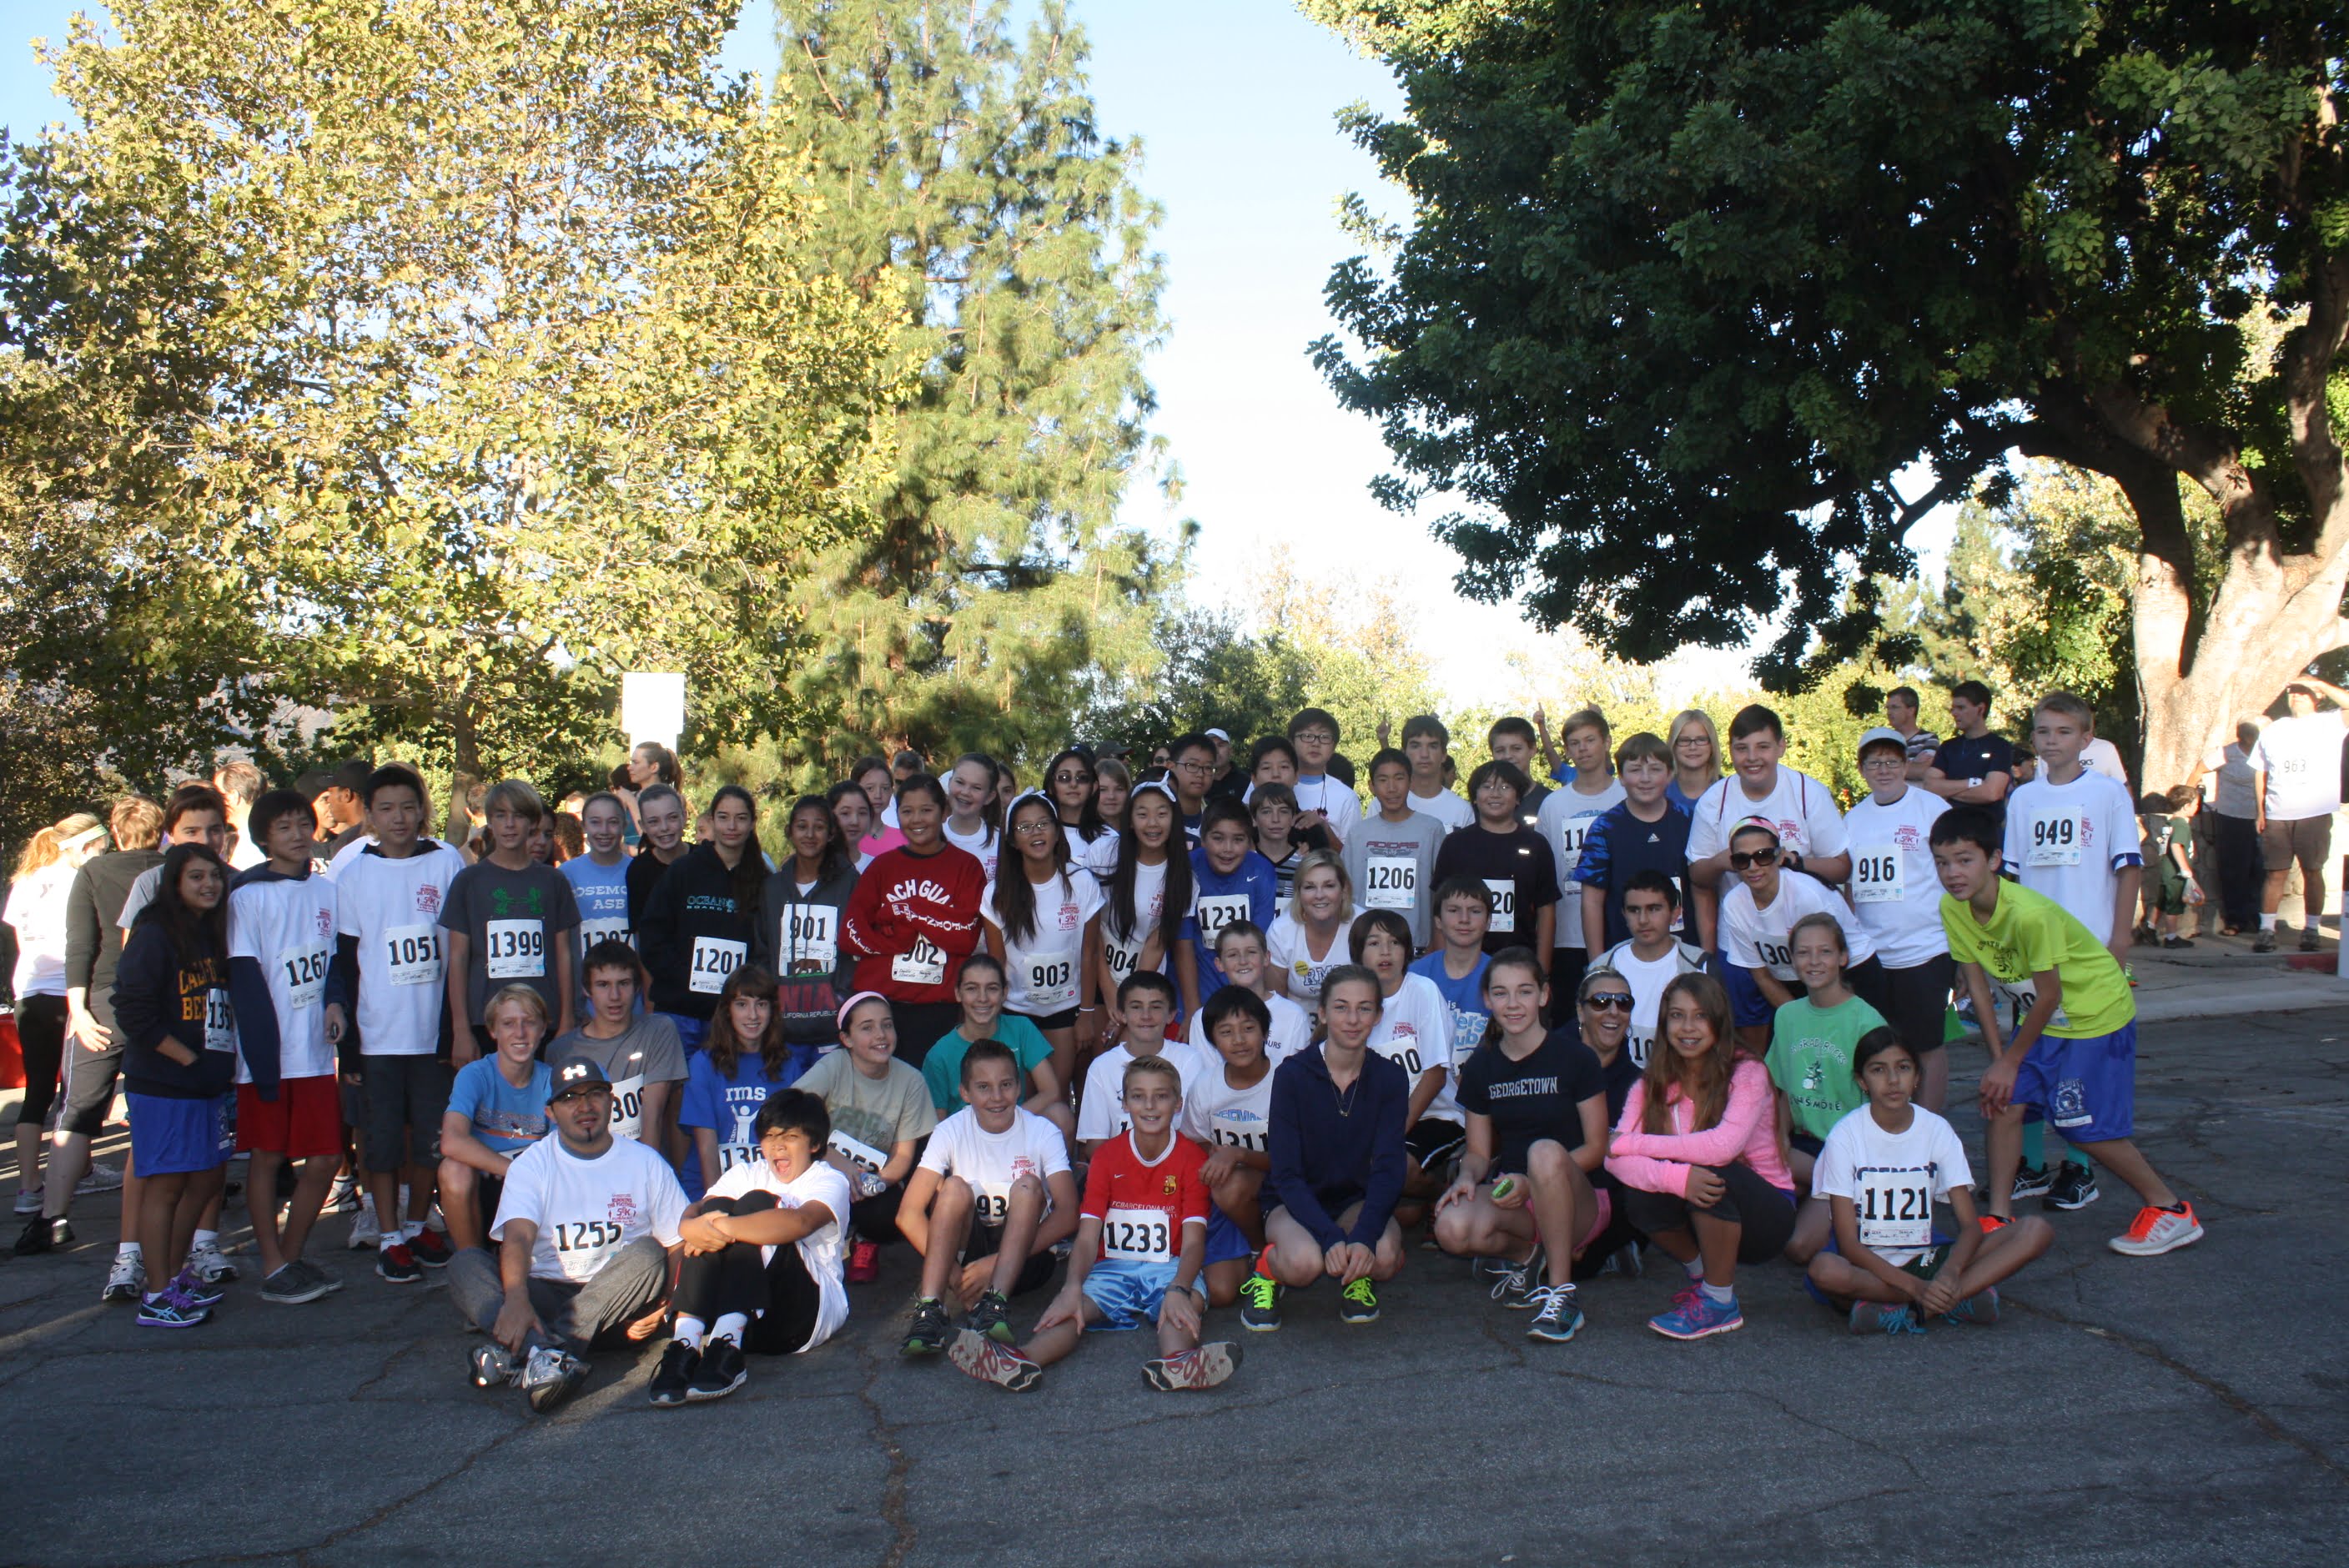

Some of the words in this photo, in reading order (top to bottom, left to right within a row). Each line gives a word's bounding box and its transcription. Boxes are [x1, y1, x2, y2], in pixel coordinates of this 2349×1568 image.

[1565, 827, 1583, 852] 11
[2035, 818, 2073, 847] 949
[1368, 867, 1415, 890] 1206
[1859, 856, 1894, 882] 916
[571, 885, 627, 898] OSEMO
[592, 898, 626, 911] ASB
[882, 878, 916, 908] ACH
[918, 879, 954, 908] GUA
[1491, 891, 1514, 914] 20
[789, 915, 827, 942] 901
[1200, 903, 1246, 931] 1231
[388, 935, 441, 966] 1051
[490, 930, 543, 958] 1399
[1753, 941, 1792, 966] 130
[285, 949, 328, 988] 1267
[694, 947, 744, 975] 1201
[1105, 943, 1139, 974] 904
[1032, 962, 1070, 988] 903
[725, 1086, 767, 1103] rms
[1488, 1076, 1558, 1100] GEORGETOWN
[722, 1145, 766, 1173] 136
[976, 1194, 1007, 1218] 93
[1864, 1187, 1929, 1220] 1121
[555, 1220, 622, 1252] 1255
[1105, 1221, 1168, 1253] 1233
